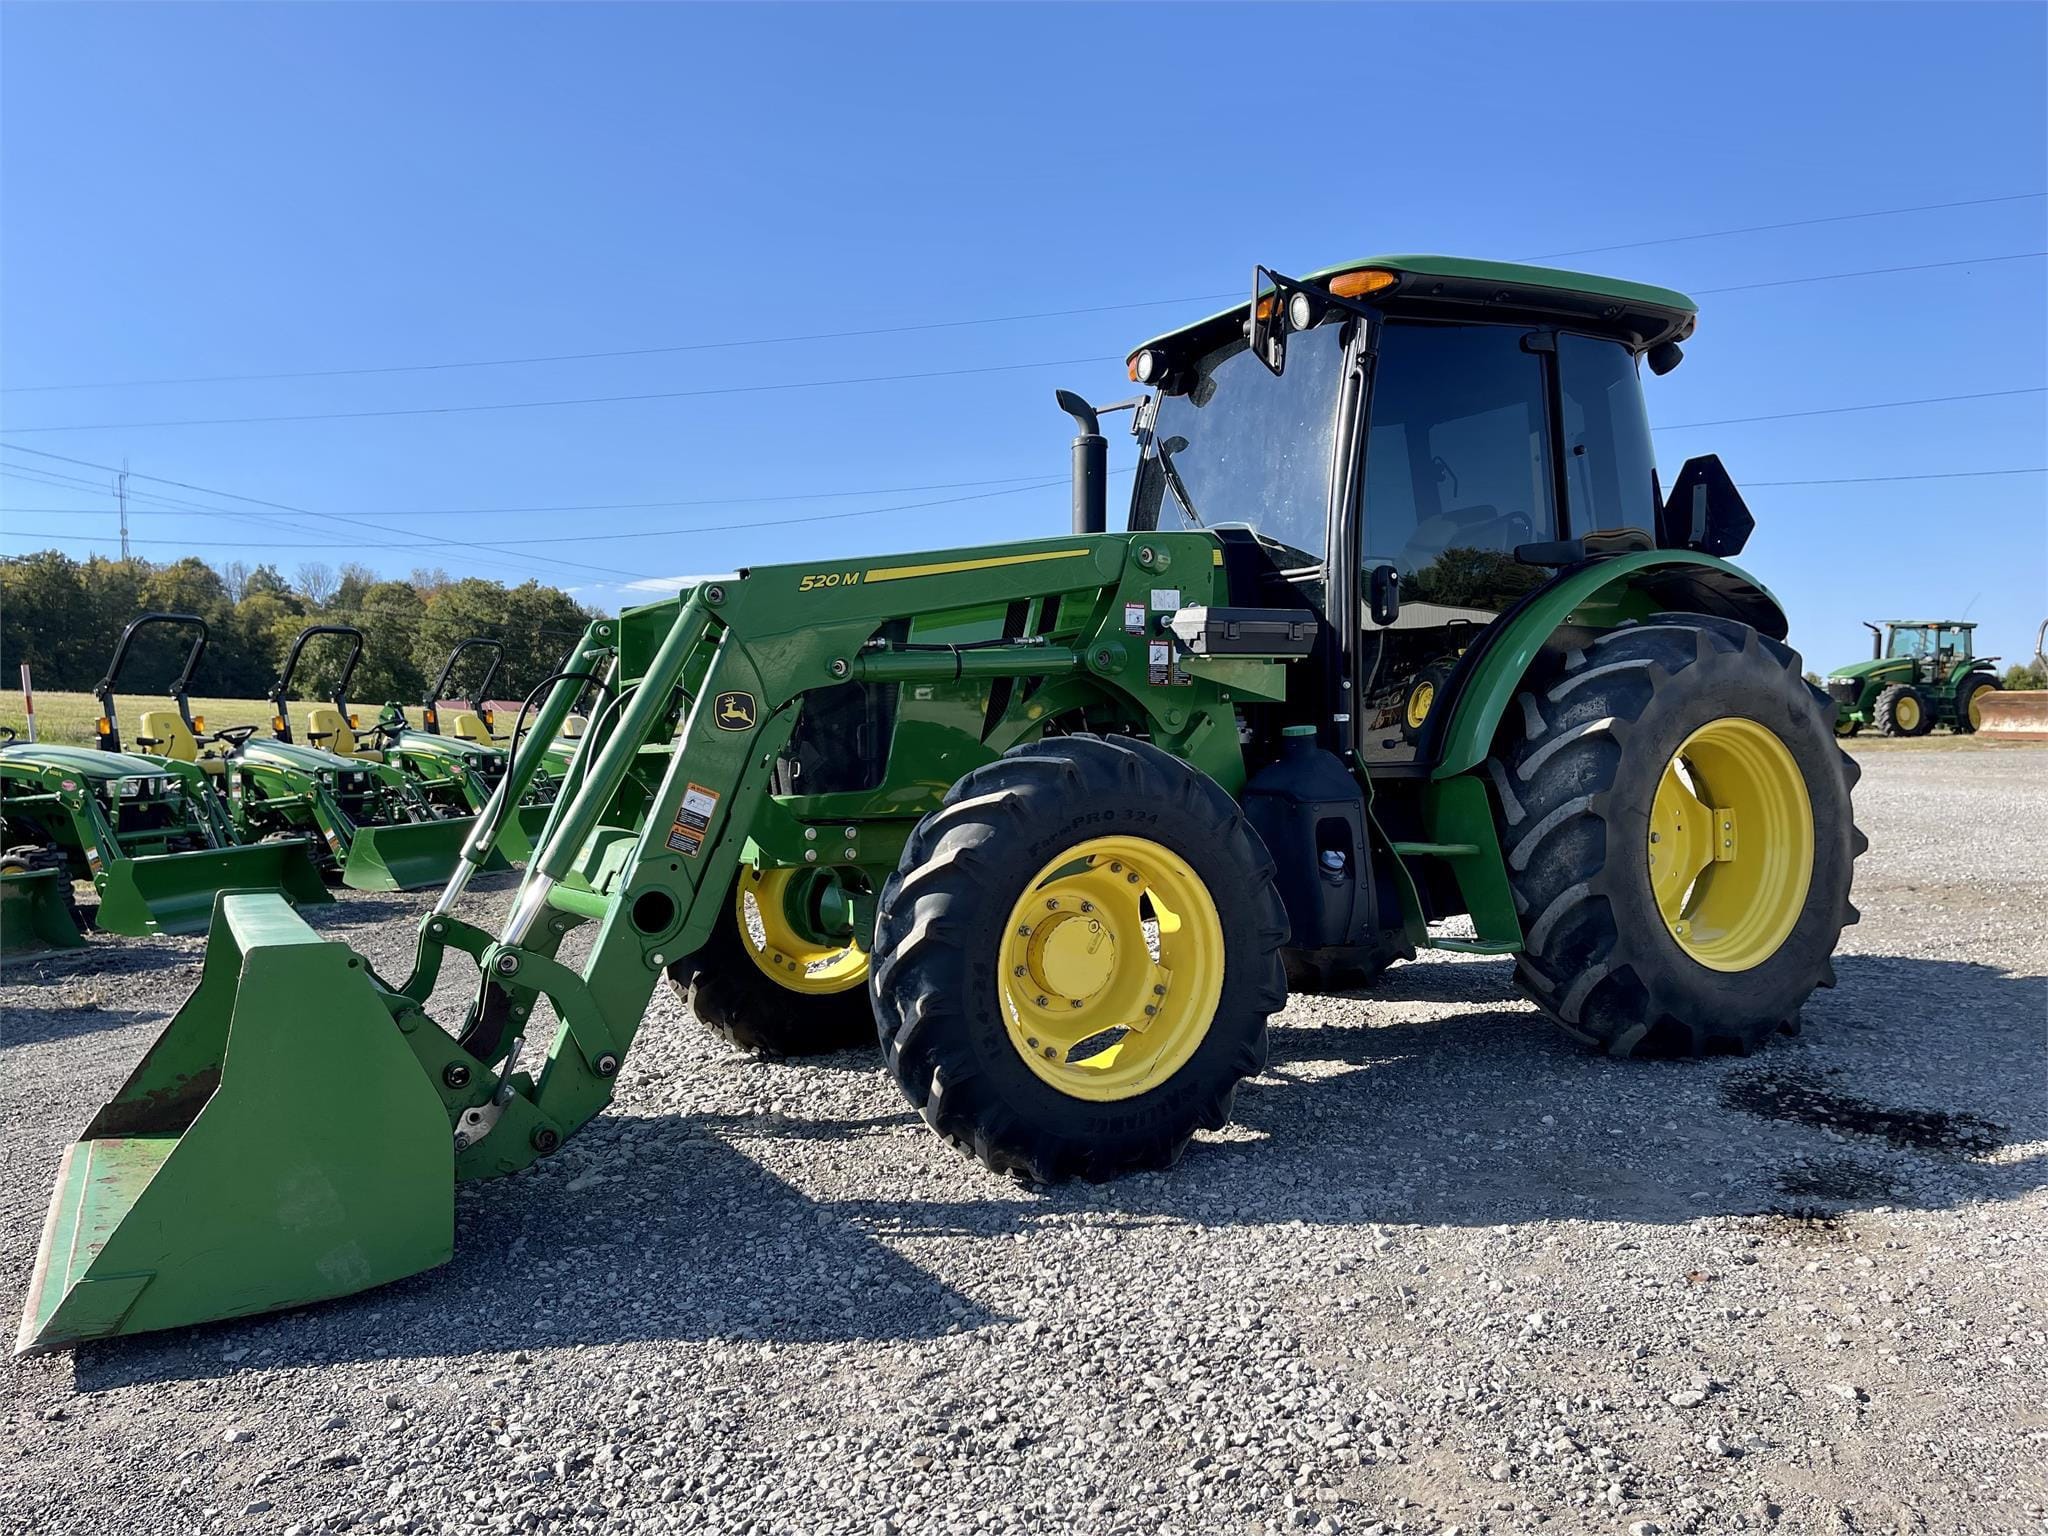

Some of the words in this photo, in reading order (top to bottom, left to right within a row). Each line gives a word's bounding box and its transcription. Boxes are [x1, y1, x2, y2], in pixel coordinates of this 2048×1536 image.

[799, 573, 840, 592] 520
[841, 571, 860, 586] M
[1122, 808, 1159, 825] 324
